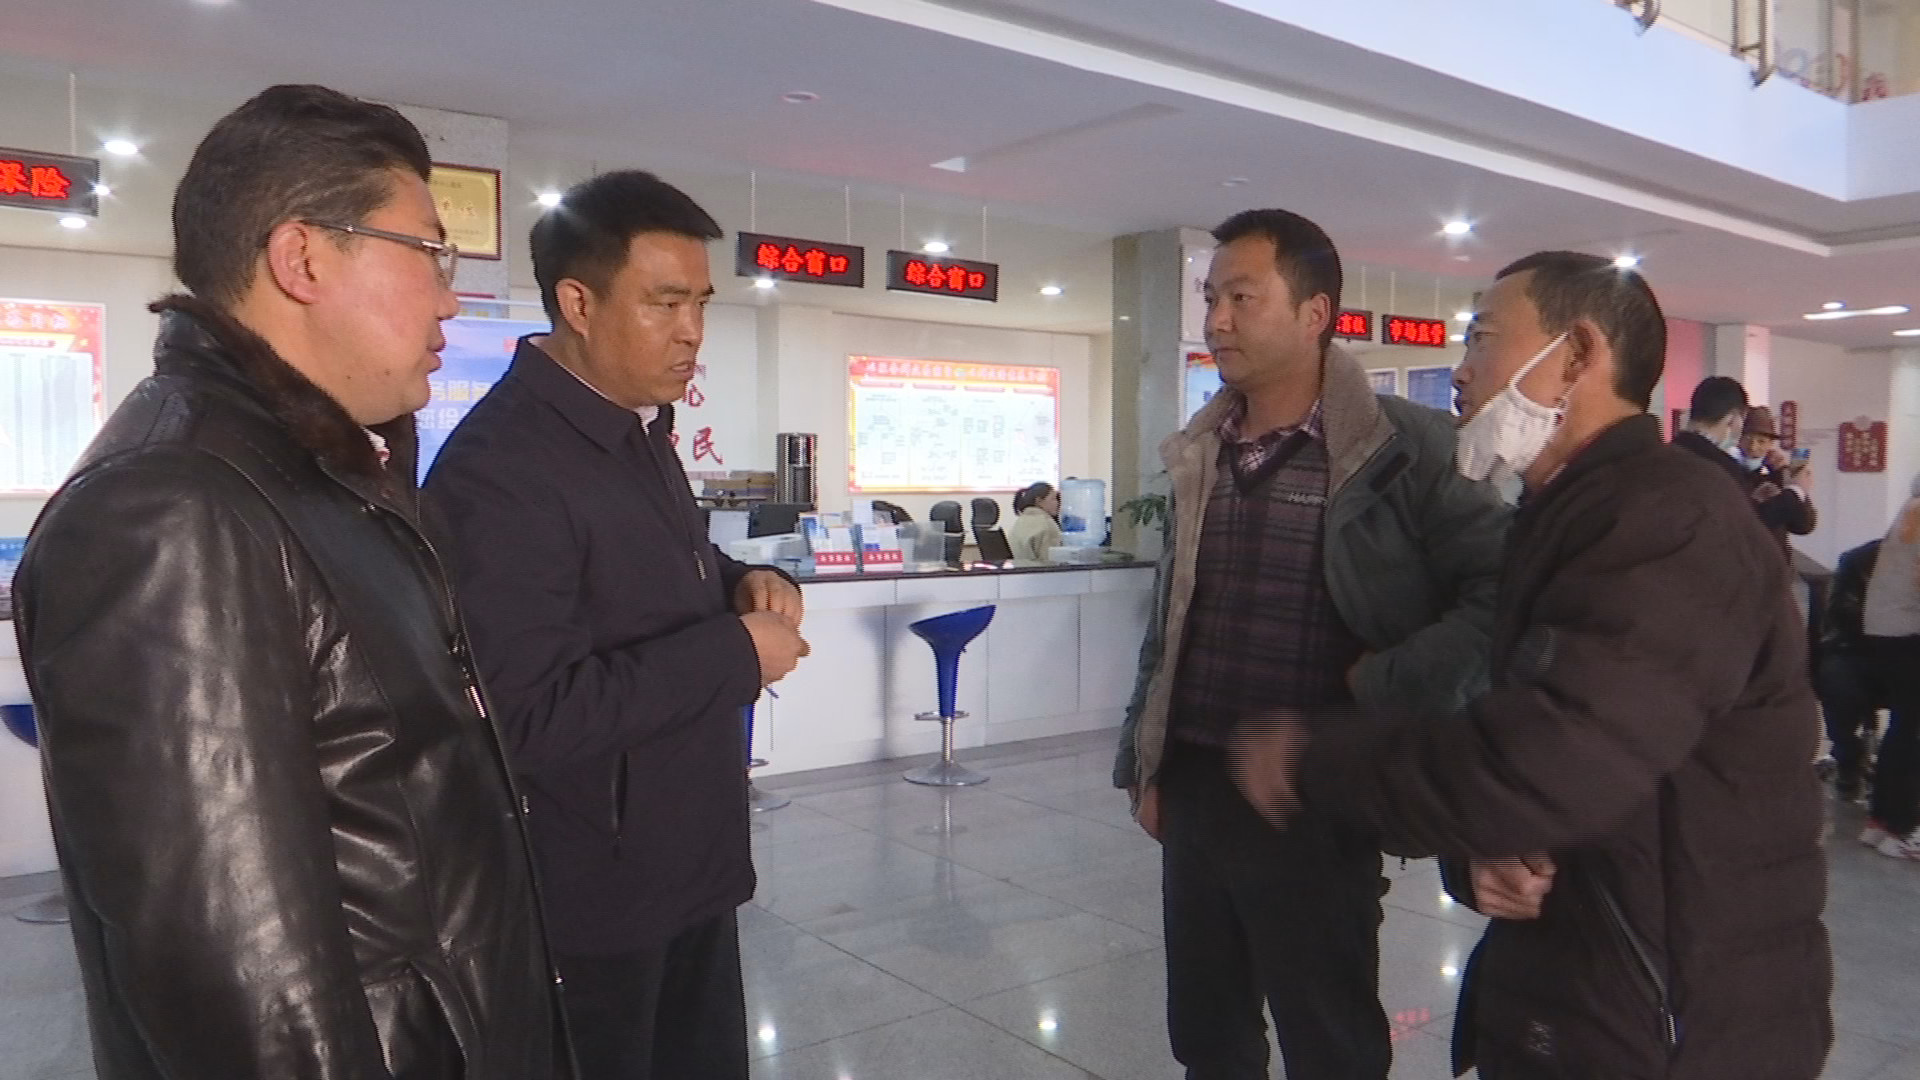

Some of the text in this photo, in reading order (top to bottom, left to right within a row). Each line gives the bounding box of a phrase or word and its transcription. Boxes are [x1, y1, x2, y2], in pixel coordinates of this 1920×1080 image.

[756, 242, 849, 276] 综合窗口
[905, 260, 986, 292] 综合窗口
